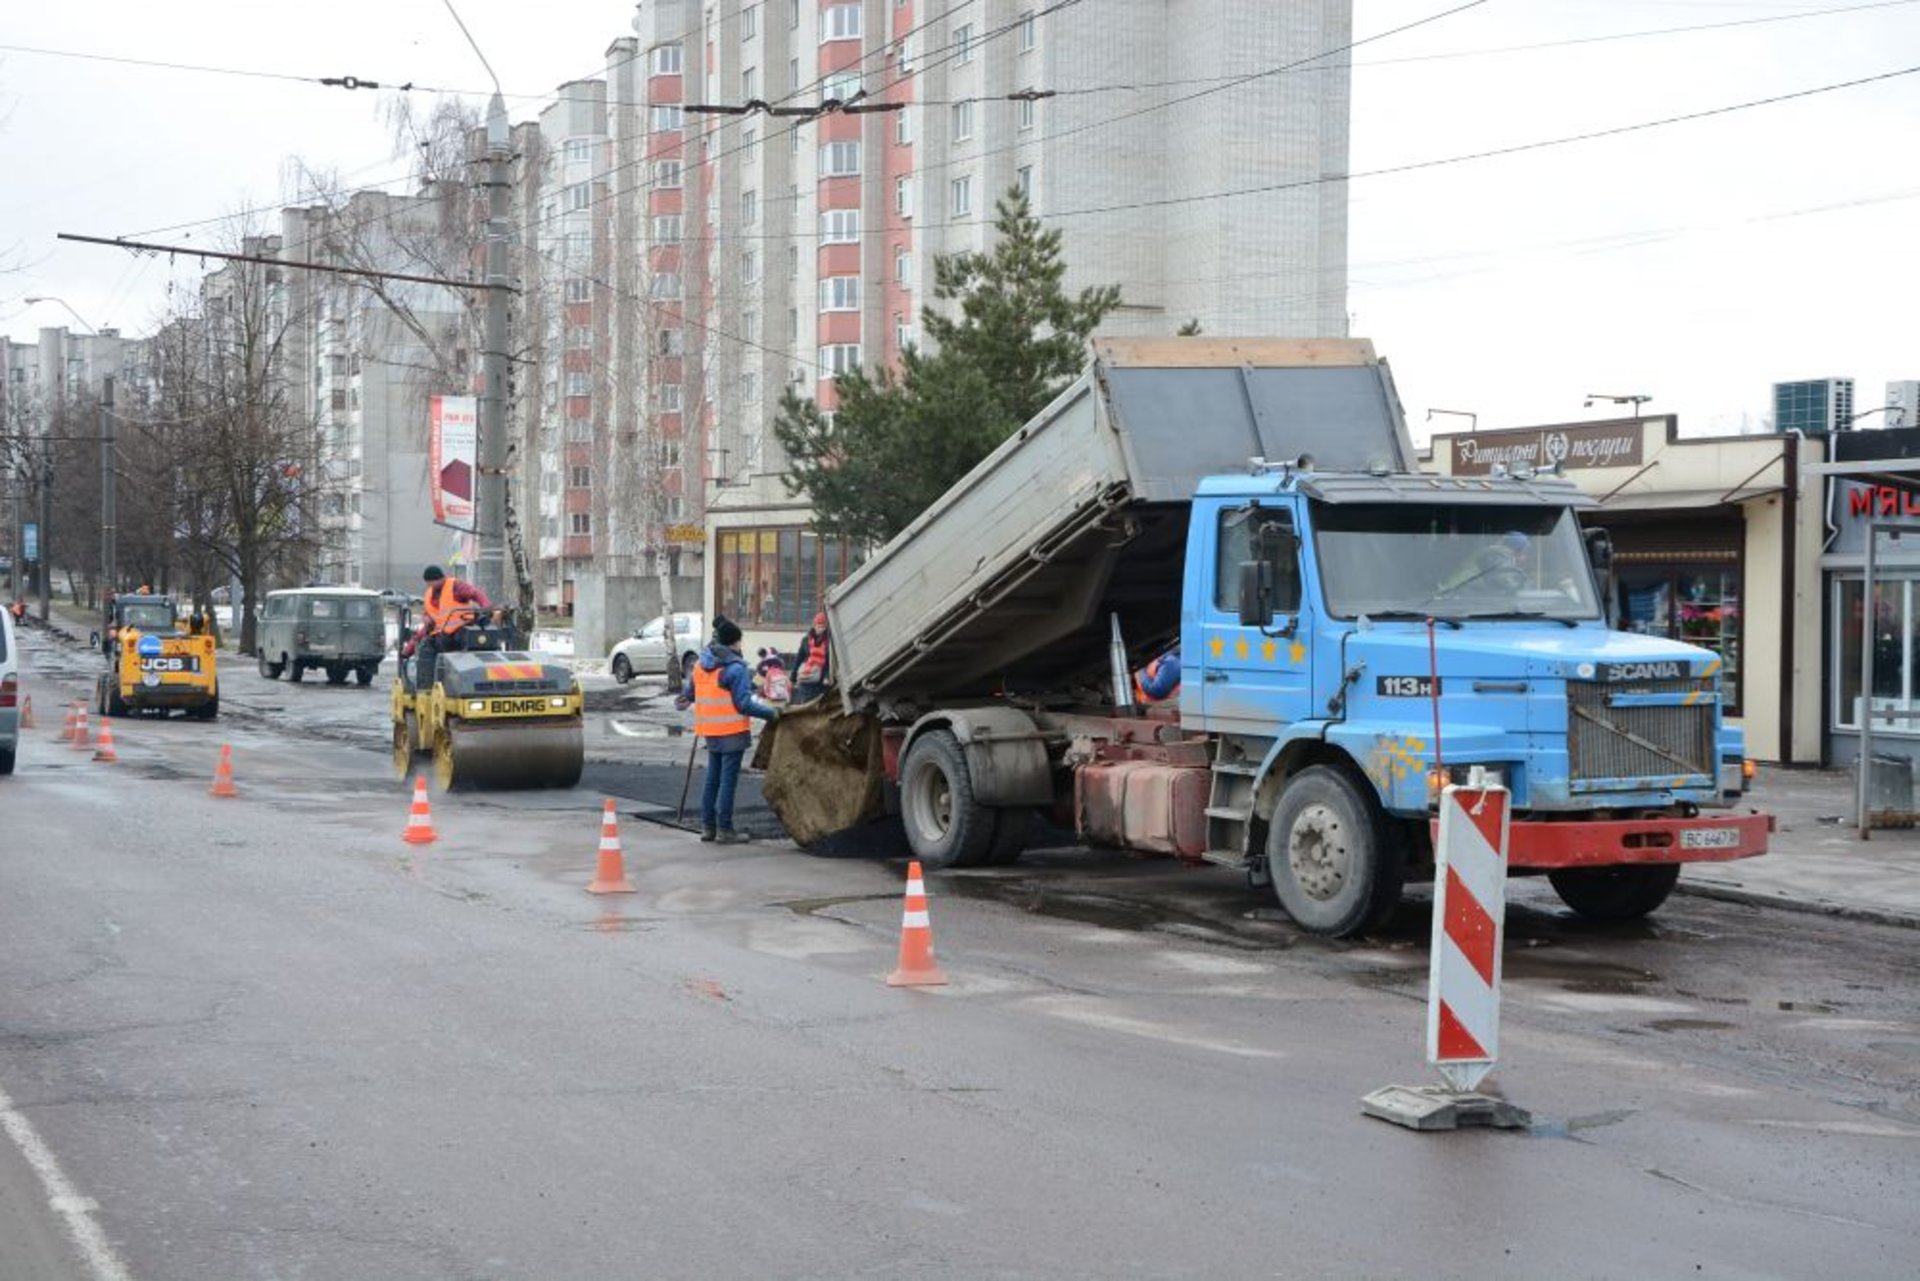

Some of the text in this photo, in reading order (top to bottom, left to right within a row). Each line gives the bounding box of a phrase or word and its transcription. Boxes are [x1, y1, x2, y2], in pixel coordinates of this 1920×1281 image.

[1572, 437, 1634, 466] послуги
[141, 658, 183, 671] JCB
[1608, 662, 1681, 680] SCANIA
[491, 700, 545, 713] BOMAG
